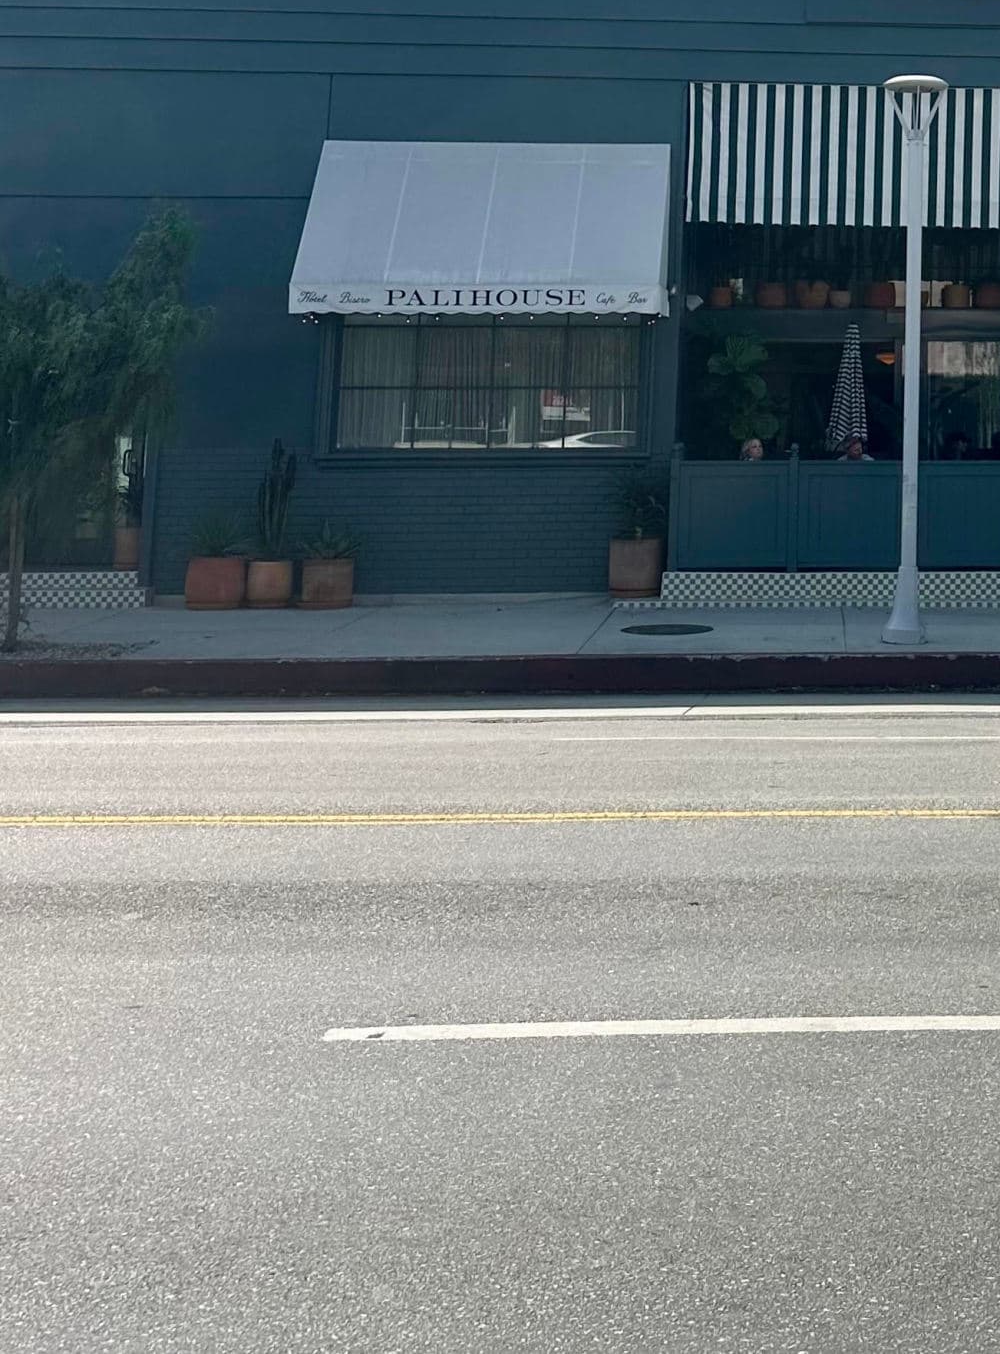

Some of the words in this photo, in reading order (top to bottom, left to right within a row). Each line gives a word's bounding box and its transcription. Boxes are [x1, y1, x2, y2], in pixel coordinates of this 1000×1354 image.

[297, 291, 327, 303] Hotel
[338, 291, 371, 304] Bistro
[384, 289, 586, 306] PALIHOUSE
[625, 291, 648, 304] Bar
